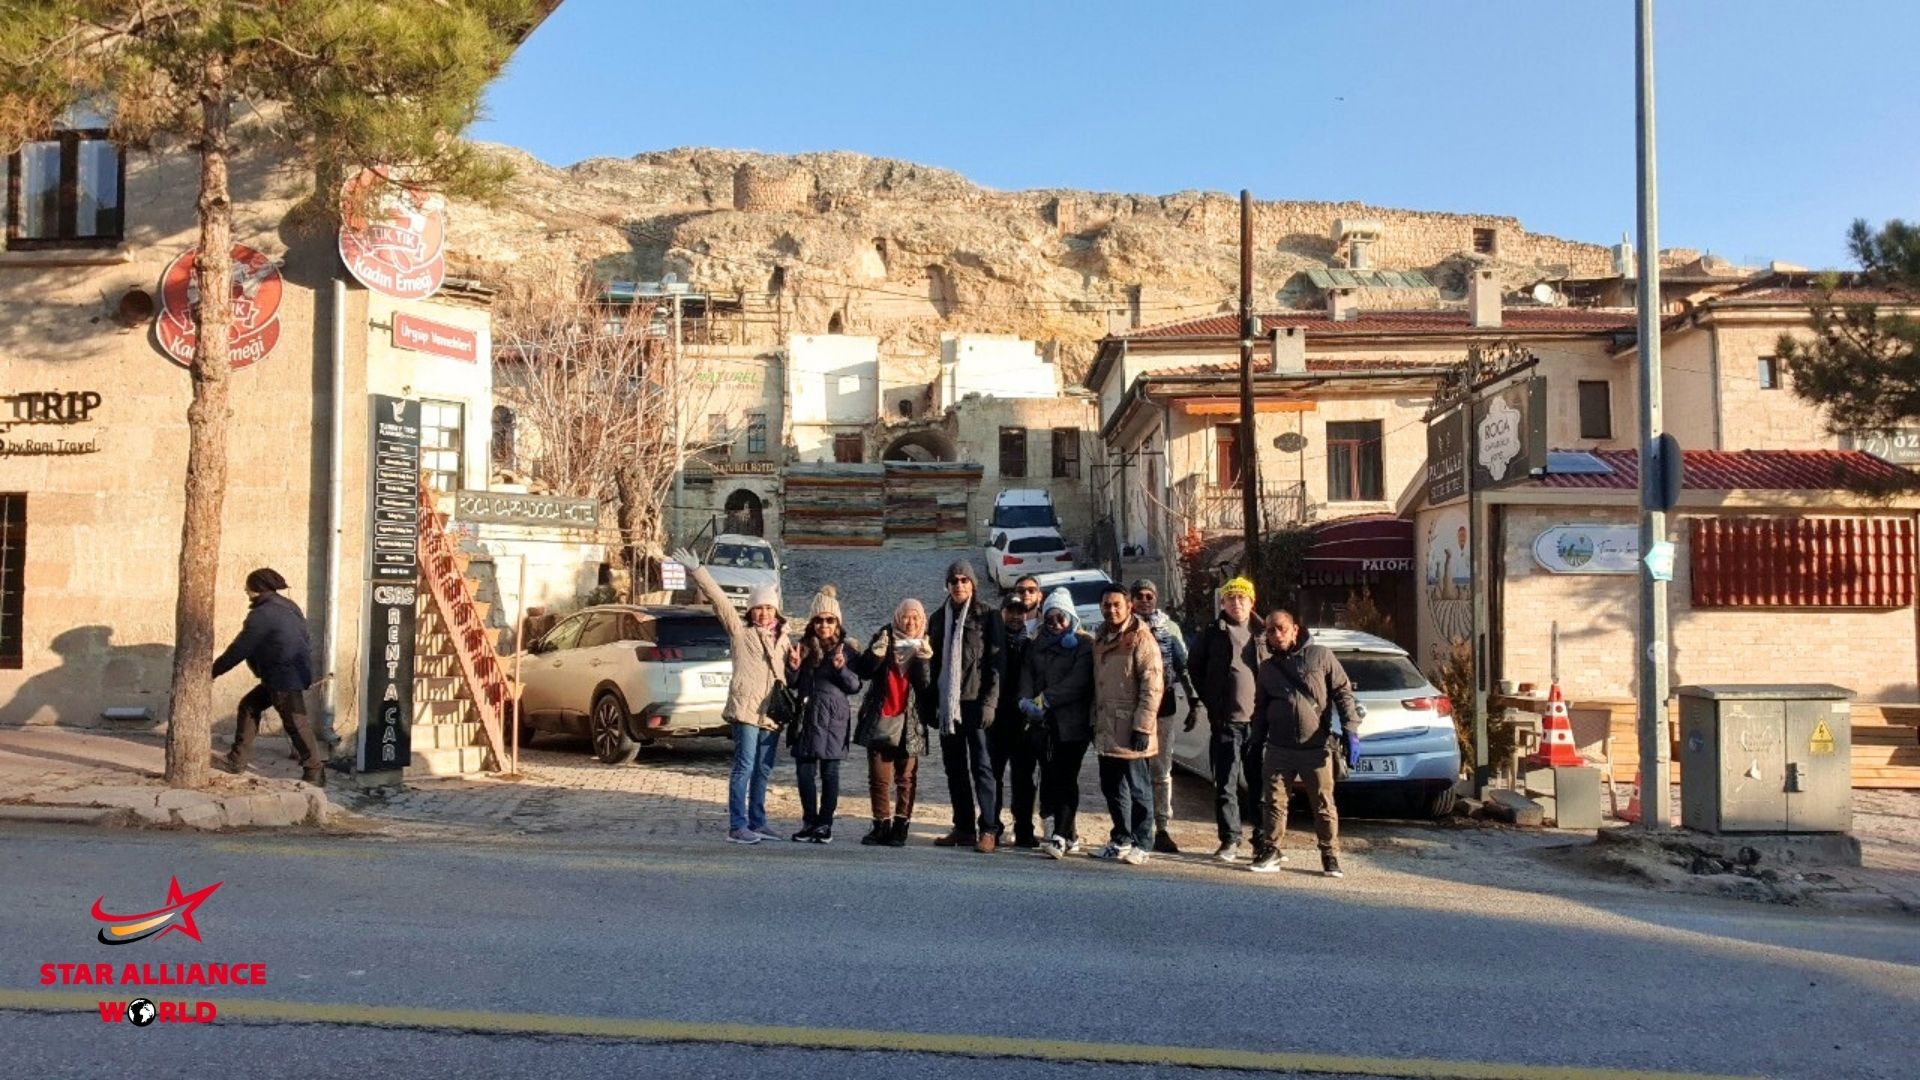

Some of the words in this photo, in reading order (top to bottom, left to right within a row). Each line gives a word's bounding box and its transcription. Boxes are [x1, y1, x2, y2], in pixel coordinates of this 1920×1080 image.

[229, 335, 265, 360] meği
[19, 391, 102, 420] TRIP
[57, 437, 96, 452] Travel
[385, 608, 400, 678] RENT
[384, 683, 399, 701] A
[382, 707, 397, 761] CAR
